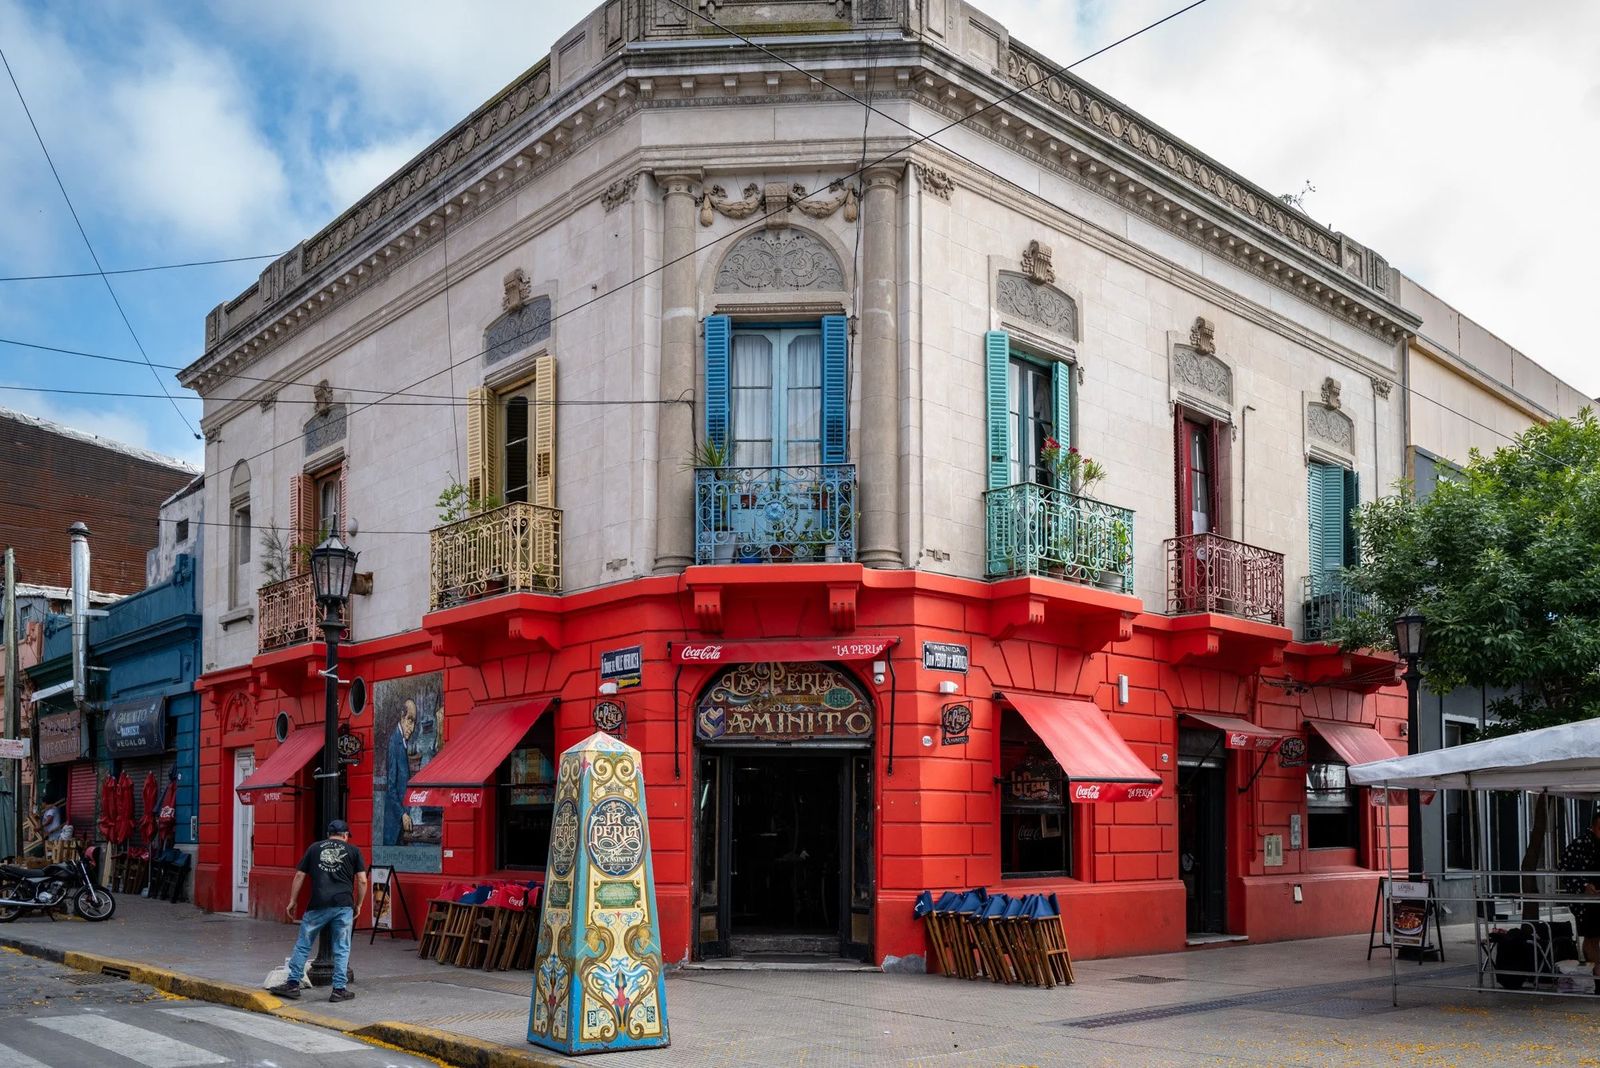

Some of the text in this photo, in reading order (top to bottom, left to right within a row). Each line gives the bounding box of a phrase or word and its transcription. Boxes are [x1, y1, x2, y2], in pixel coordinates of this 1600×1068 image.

[681, 646, 723, 660] Coca-Cola
[933, 644, 961, 653] AVENIDA
[757, 662, 842, 694] PERLA
[700, 707, 872, 738] CAMINITO
[1230, 734, 1248, 747] Coca-Cola
[409, 790, 429, 803] Coca-Cola
[1075, 785, 1101, 799] Coca-Cola
[606, 811, 623, 824] LA
[592, 825, 639, 843] PERLA
[599, 856, 637, 864] CAMINITO
